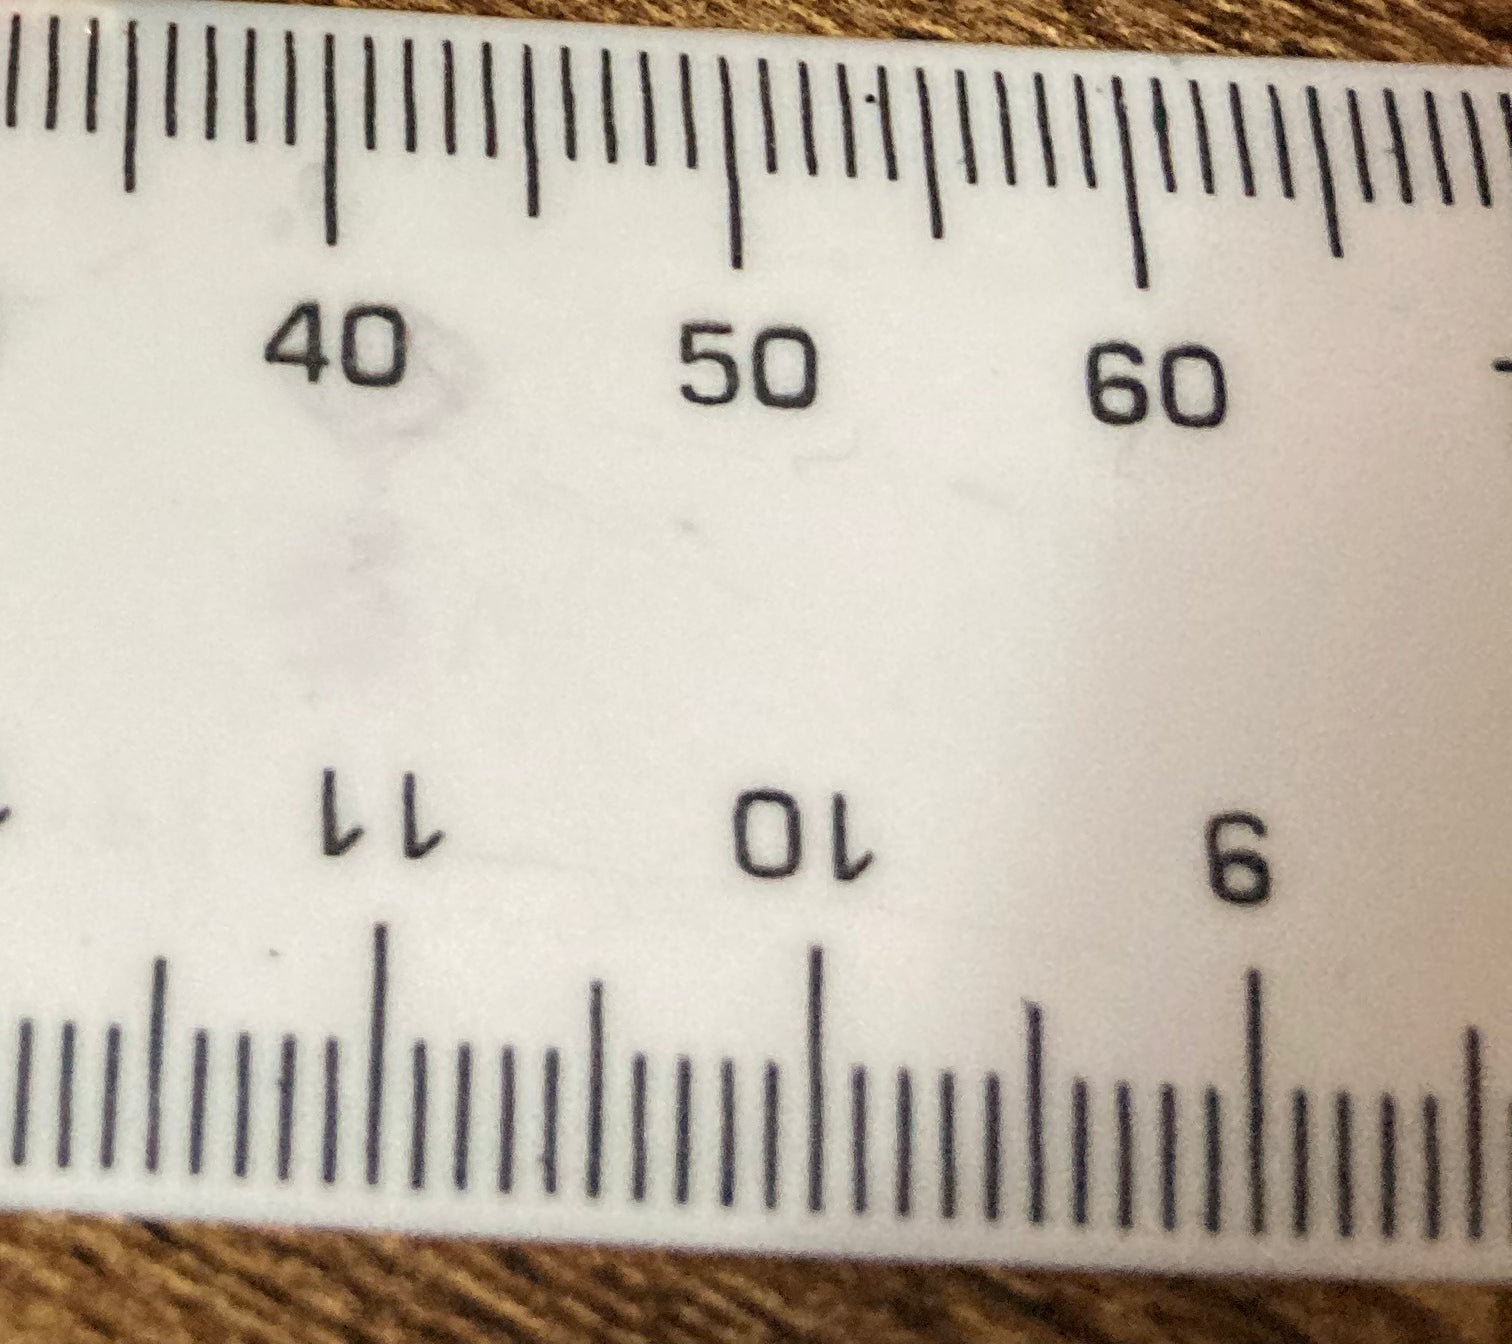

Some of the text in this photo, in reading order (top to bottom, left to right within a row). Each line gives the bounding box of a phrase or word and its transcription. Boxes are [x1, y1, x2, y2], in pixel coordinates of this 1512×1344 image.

[261, 298, 413, 390] 40
[677, 318, 821, 412] 50
[1083, 338, 1231, 432] 60
[317, 765, 448, 862] 11
[729, 785, 878, 887] 10
[1202, 808, 1275, 912] 9
